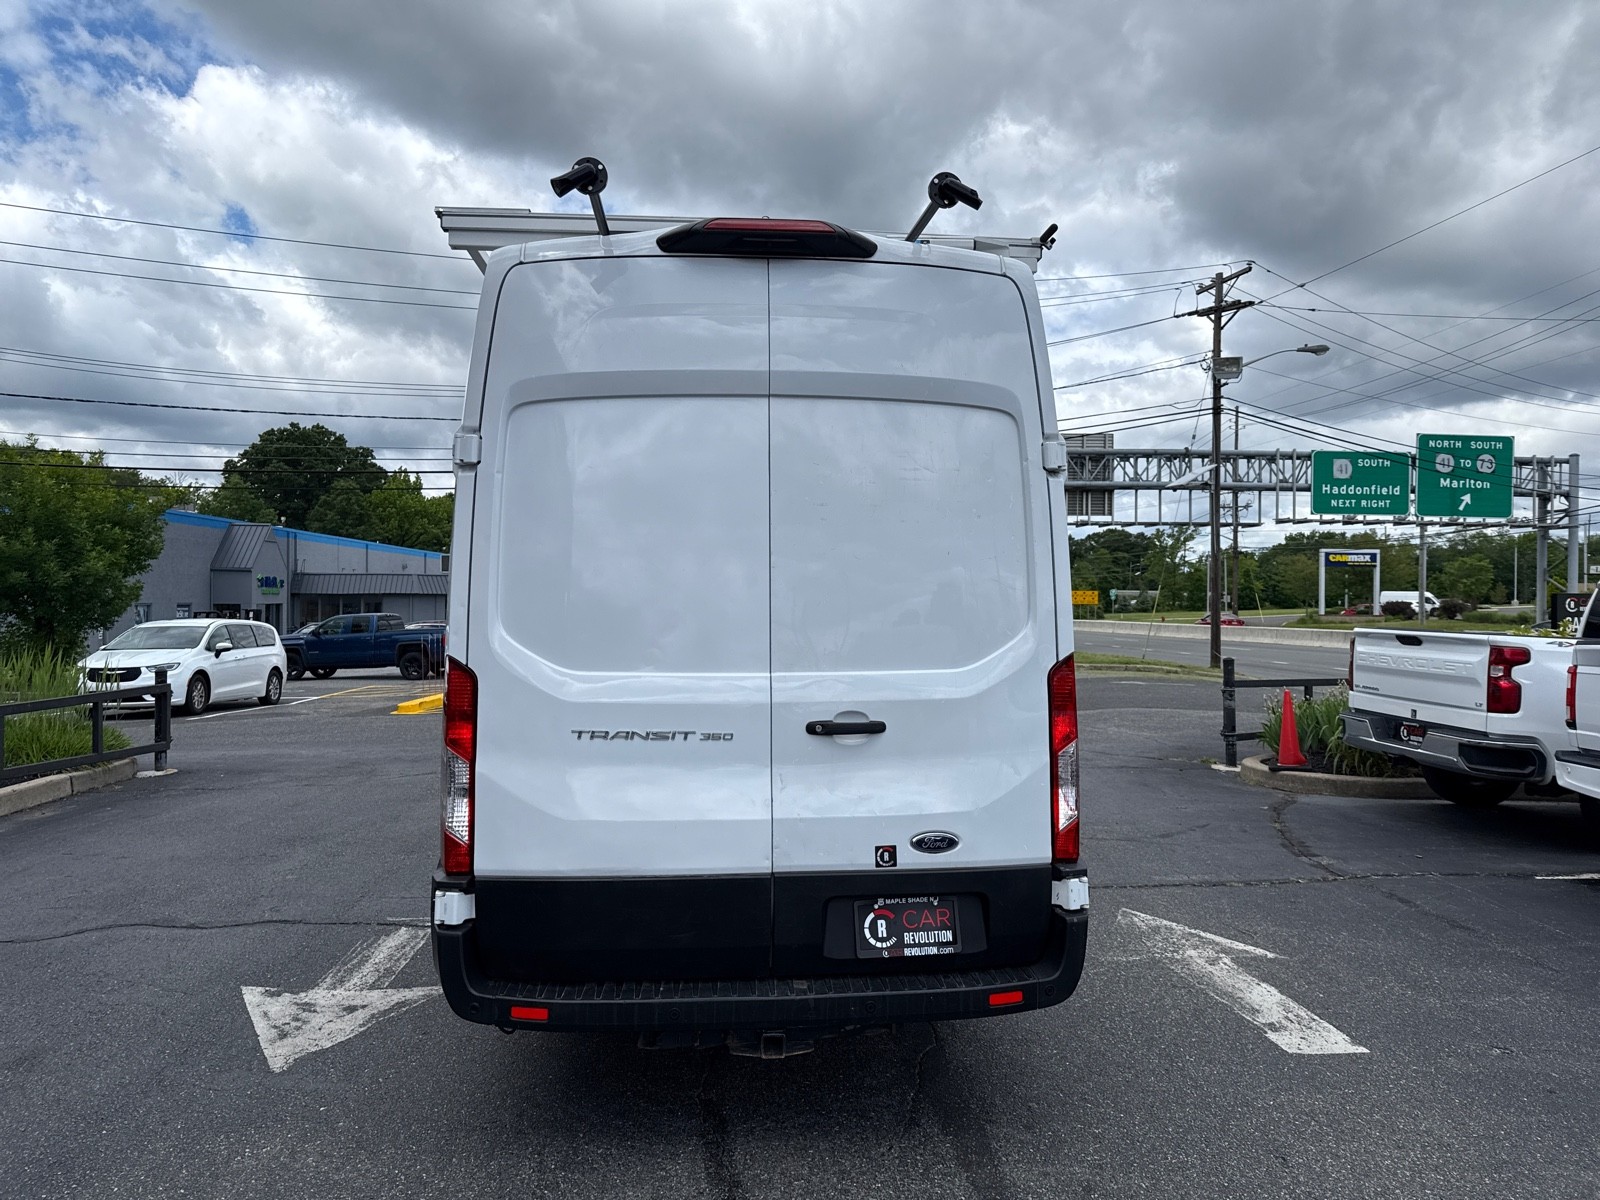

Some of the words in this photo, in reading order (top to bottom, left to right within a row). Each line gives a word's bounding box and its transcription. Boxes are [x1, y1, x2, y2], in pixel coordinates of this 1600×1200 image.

[1428, 440, 1462, 448] NORTH
[1470, 441, 1503, 450] SOUTH
[1336, 463, 1348, 475] 41
[1357, 459, 1391, 467] SOUTH
[1440, 457, 1450, 469] 41
[1460, 459, 1472, 468] TO
[1478, 458, 1494, 470] 73
[1322, 484, 1401, 495] Haddonfield
[1440, 478, 1491, 489] Marlton
[1361, 500, 1391, 508] RIGHT
[1357, 653, 1473, 674] CHEVROLET
[571, 730, 696, 741] TRANSIT
[699, 732, 734, 741] 350
[922, 836, 949, 849] Ford
[902, 908, 951, 929] CAR
[903, 930, 953, 945] REVOLUTION
